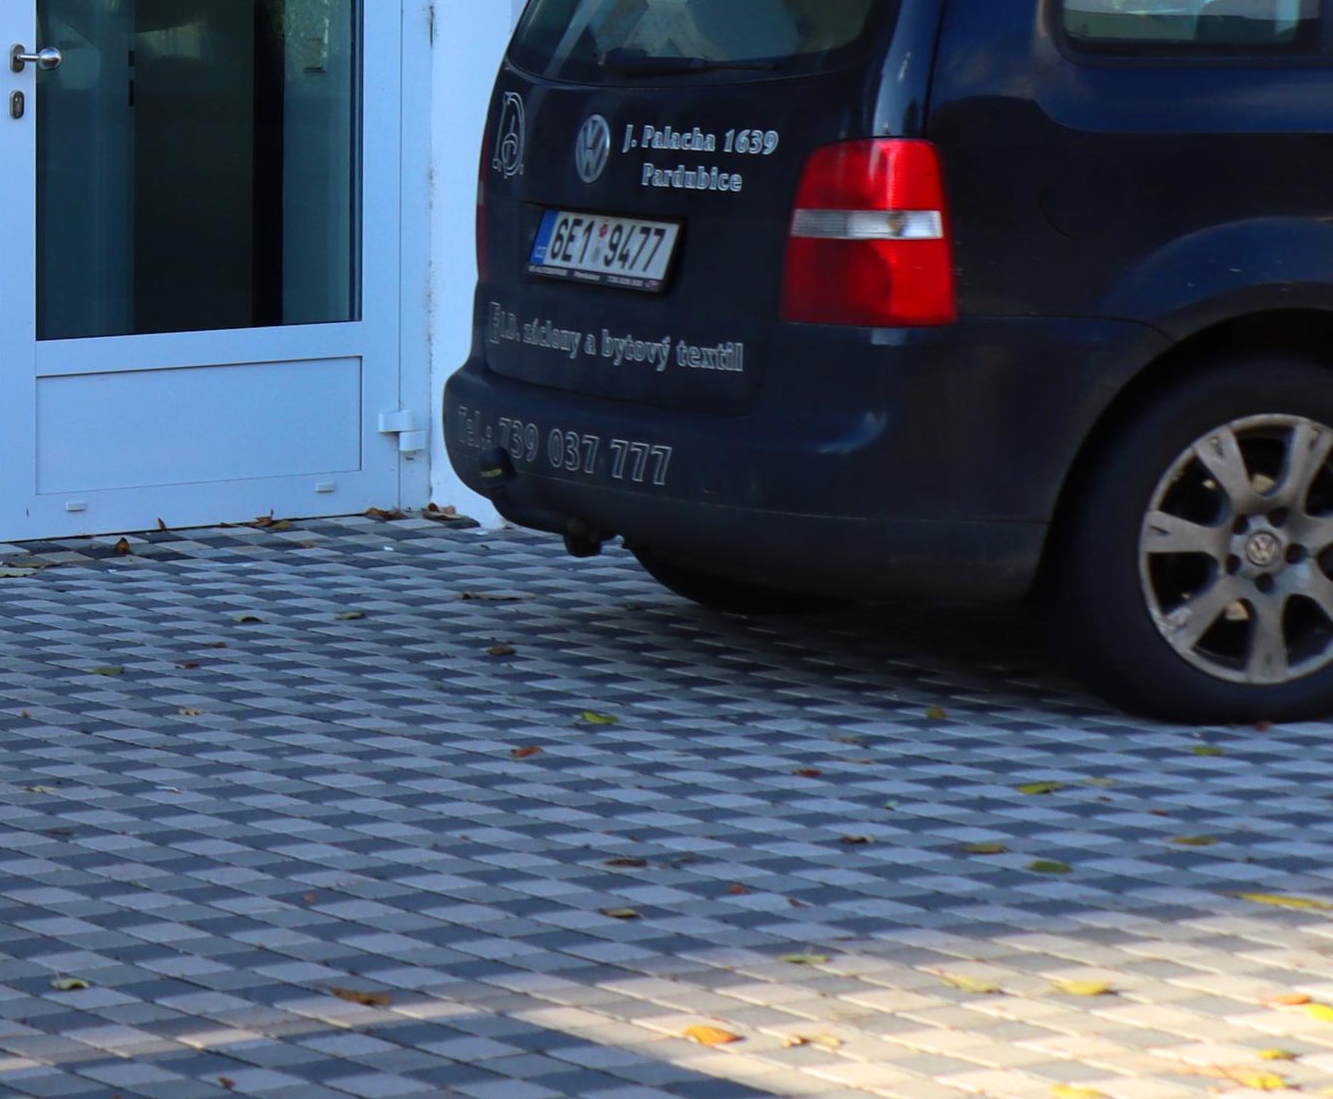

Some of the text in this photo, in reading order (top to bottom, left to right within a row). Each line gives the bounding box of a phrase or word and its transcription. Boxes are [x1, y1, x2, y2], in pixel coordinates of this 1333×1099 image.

[622, 124, 779, 155] J. Palacha 1639
[641, 162, 743, 193] Pardubice
[549, 217, 667, 273] 6E1 9477
[586, 333, 597, 356] a
[601, 329, 671, 372] bytový
[676, 340, 744, 373] textil
[498, 416, 540, 463] 739
[547, 428, 601, 475] 037
[610, 438, 673, 486] 777
